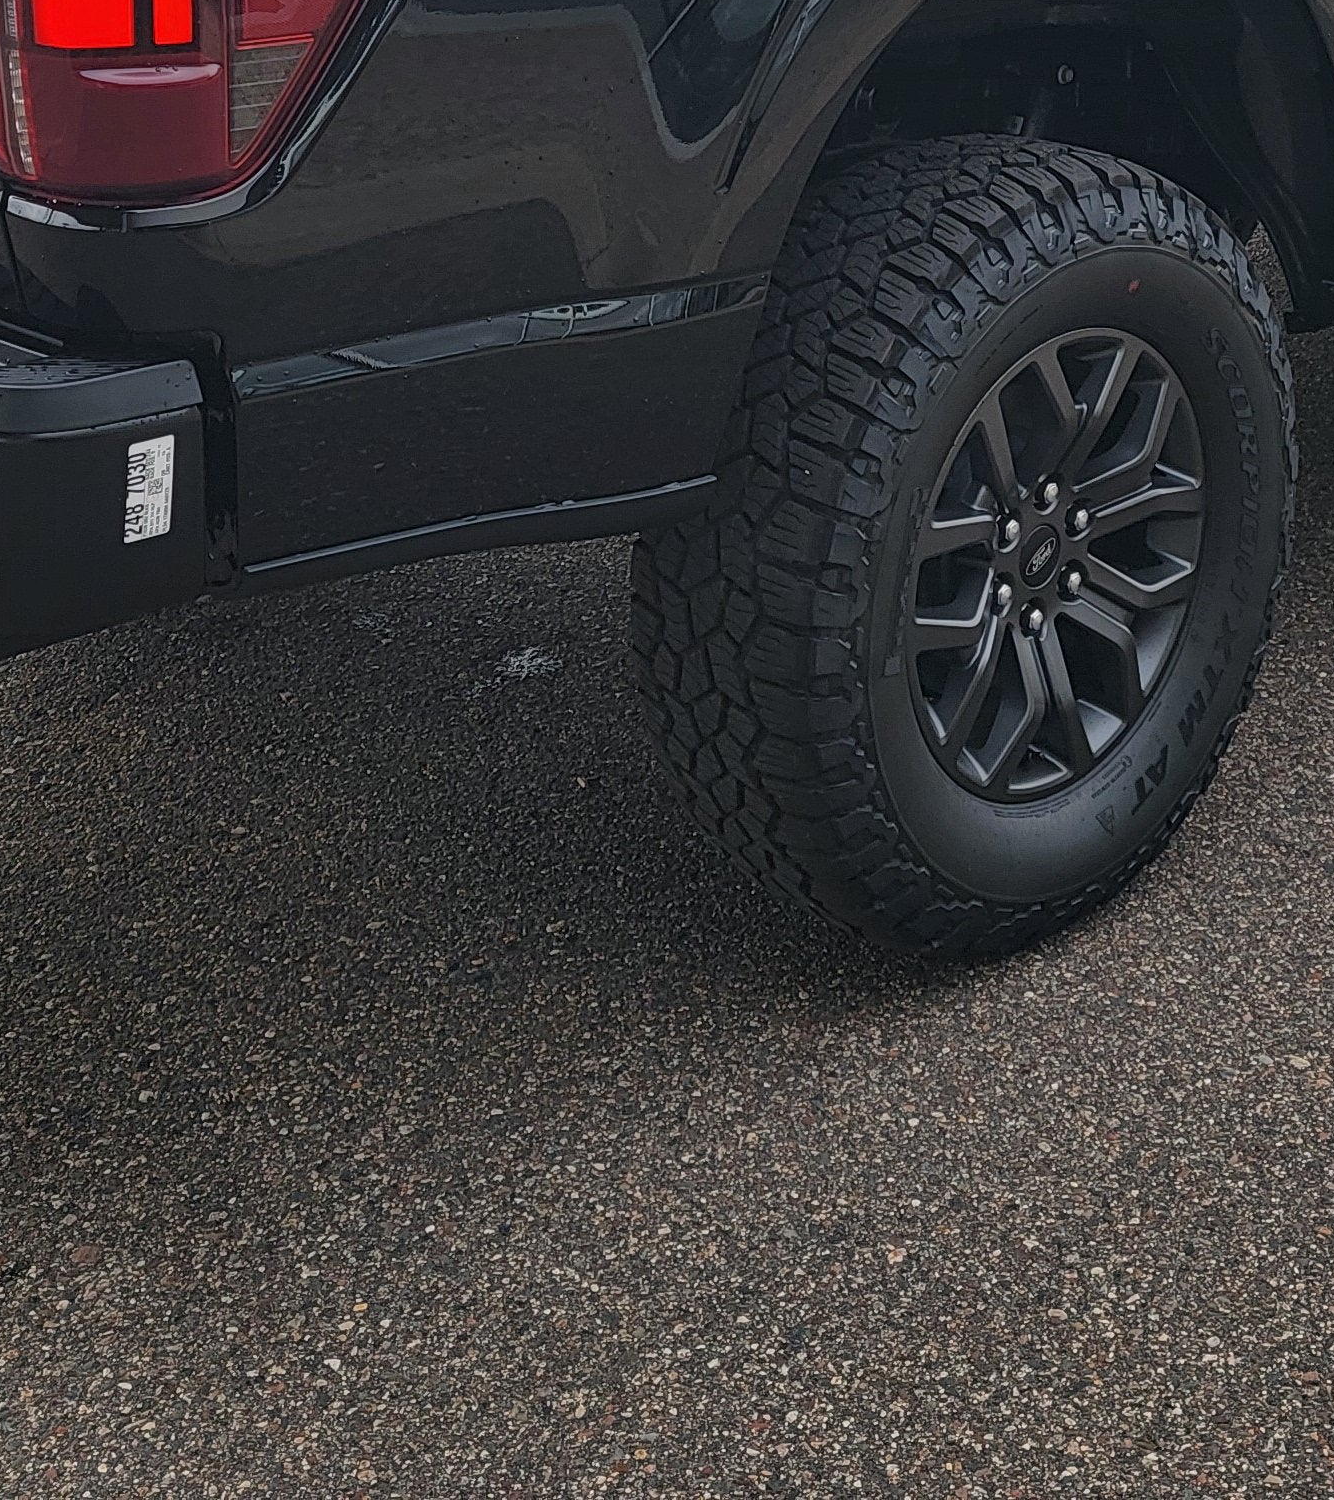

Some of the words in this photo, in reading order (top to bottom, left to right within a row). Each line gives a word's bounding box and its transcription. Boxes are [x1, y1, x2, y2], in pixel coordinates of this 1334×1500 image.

[127, 452, 147, 500] 7030
[124, 503, 145, 538] 248
[1031, 543, 1053, 572] Ford
[1130, 743, 1170, 817] AT
